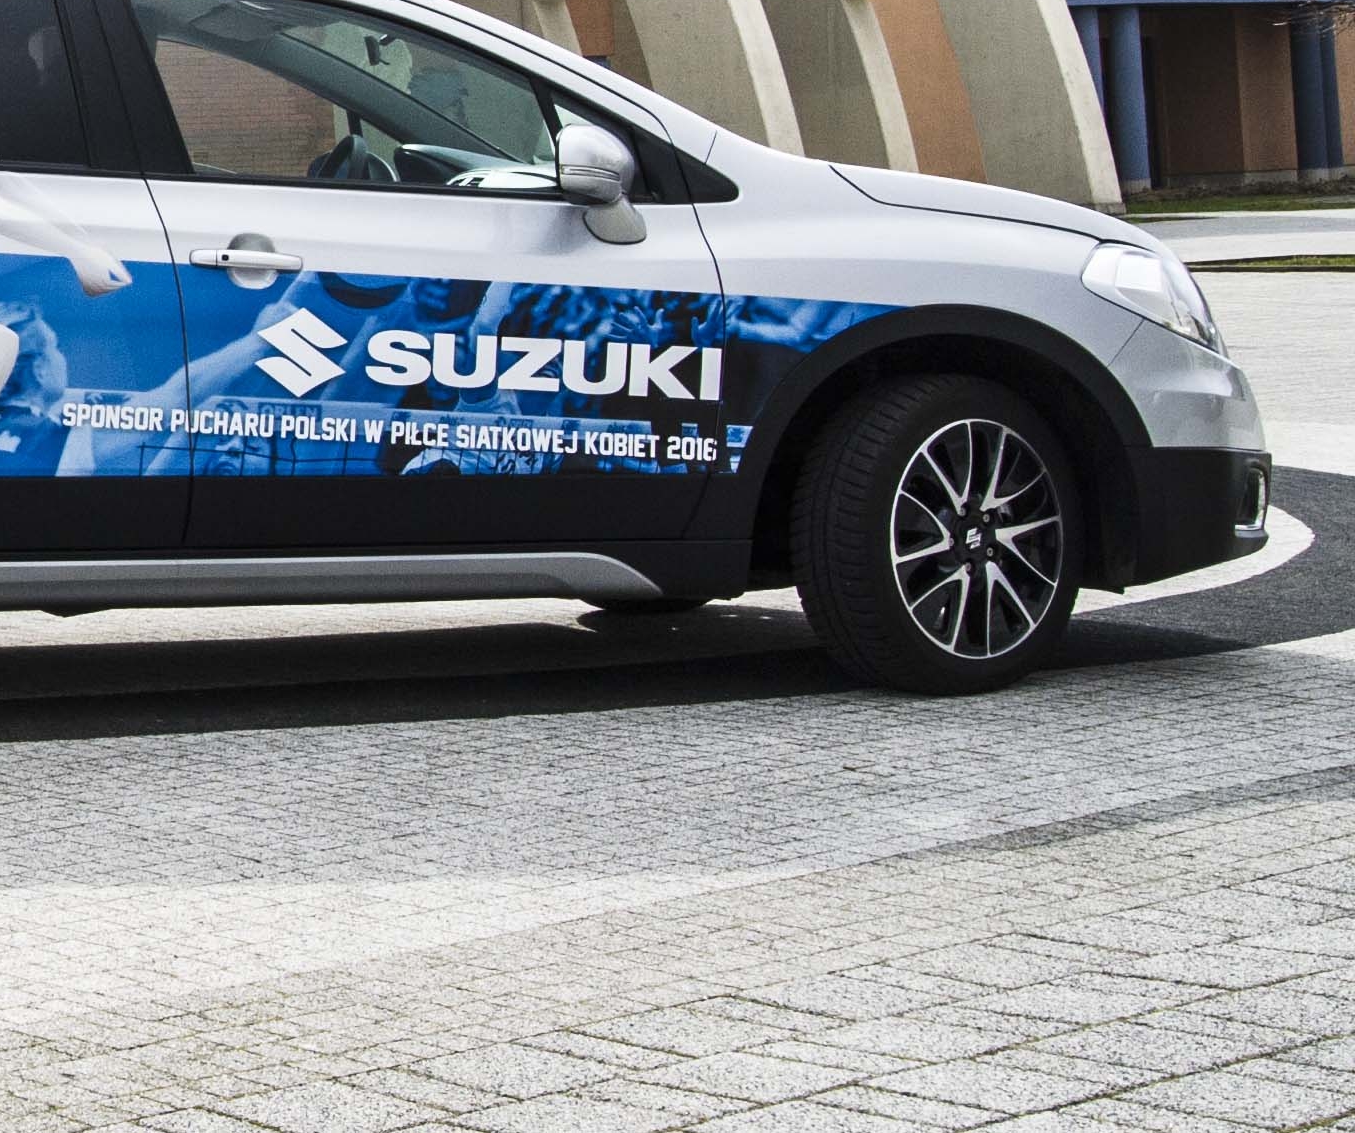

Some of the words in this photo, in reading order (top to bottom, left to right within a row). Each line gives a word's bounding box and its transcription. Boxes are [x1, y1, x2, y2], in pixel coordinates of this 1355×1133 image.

[366, 329, 722, 401] SUZUKI
[62, 402, 164, 432] SPONSOR
[170, 408, 274, 438] PUCHARU
[281, 414, 356, 442] POLSKI
[363, 419, 384, 444] W
[391, 420, 449, 447] PIŁCE
[456, 424, 578, 454] SIATKOWEJ
[585, 431, 660, 458] KOBIET
[667, 436, 717, 461] 2016
